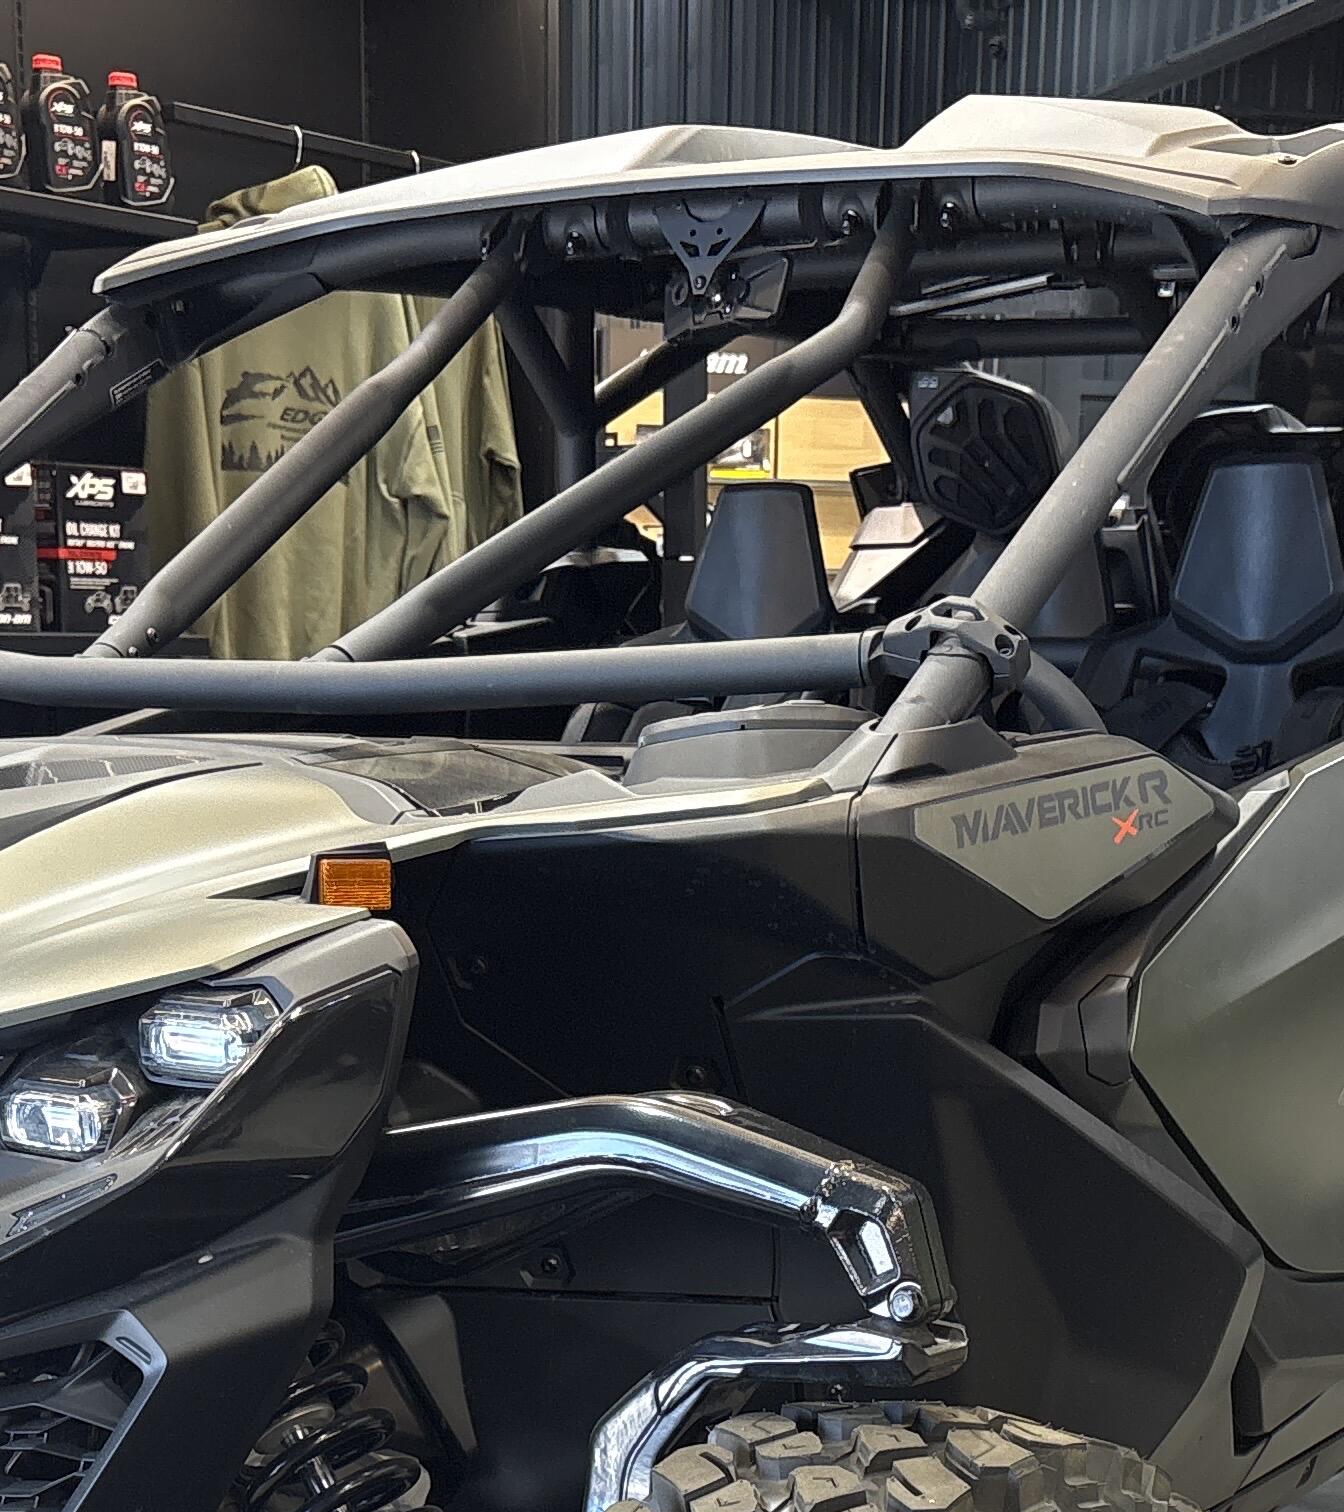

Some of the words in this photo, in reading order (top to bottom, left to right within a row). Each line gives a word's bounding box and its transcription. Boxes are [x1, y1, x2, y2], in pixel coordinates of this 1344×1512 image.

[280, 407, 330, 425] EDG
[66, 472, 116, 500] XPS
[952, 775, 1136, 849] MAVERICK
[1138, 769, 1172, 804] R
